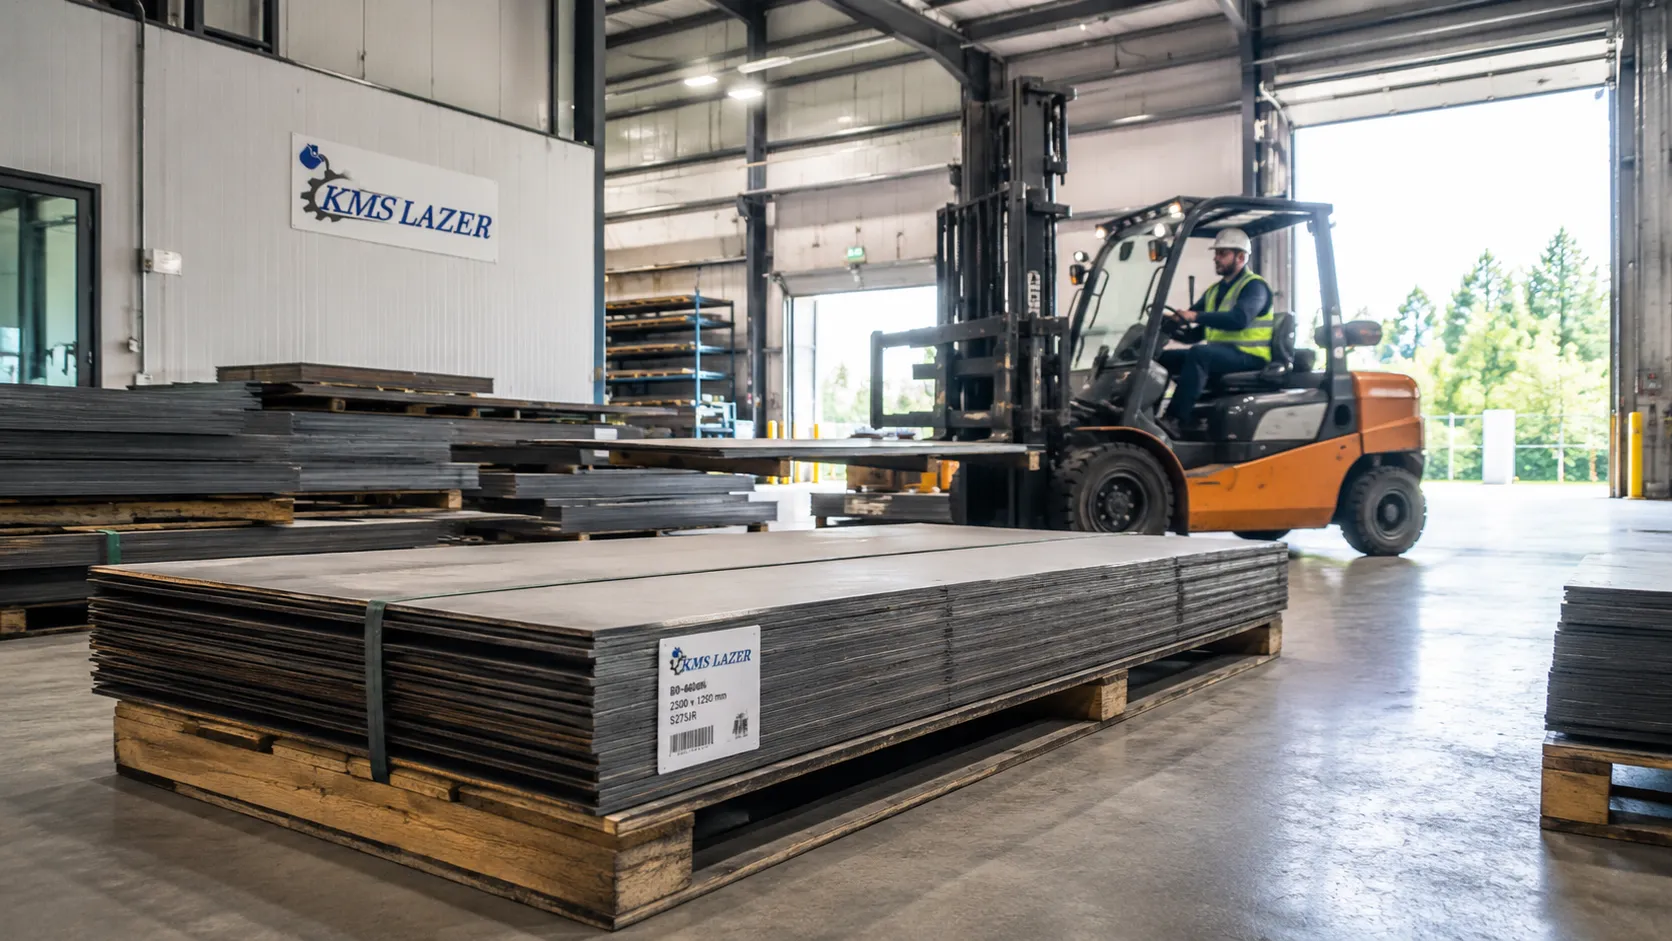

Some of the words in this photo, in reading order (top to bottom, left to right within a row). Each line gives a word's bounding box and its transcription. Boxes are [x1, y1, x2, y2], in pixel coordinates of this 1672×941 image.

[320, 185, 397, 221] KMS
[398, 199, 493, 239] LAZER
[682, 655, 711, 672] KMS
[712, 649, 752, 668] LAZER
[670, 699, 688, 711] 2500
